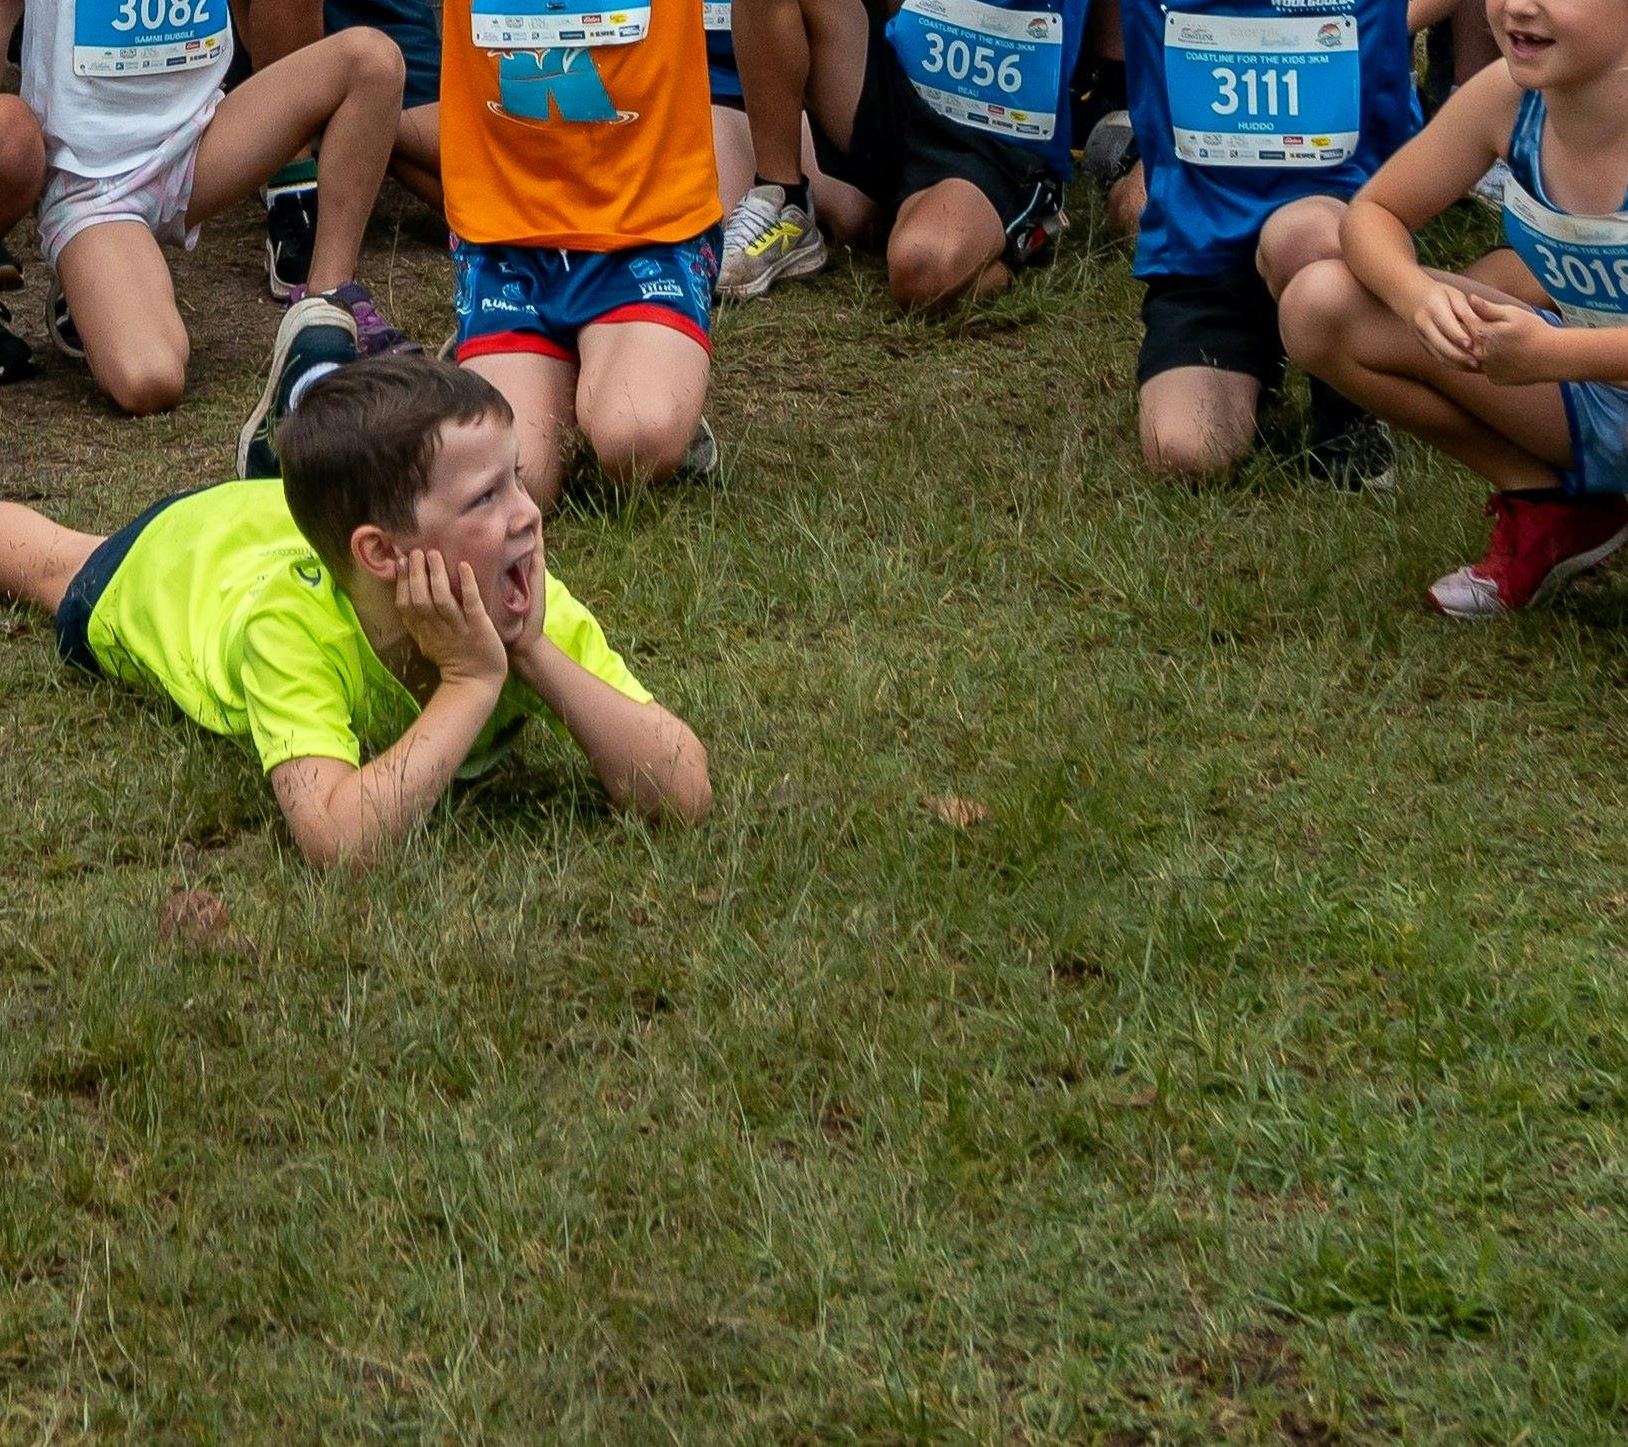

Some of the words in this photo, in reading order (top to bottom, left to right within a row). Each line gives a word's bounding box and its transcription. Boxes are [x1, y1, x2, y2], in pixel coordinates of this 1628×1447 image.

[918, 17, 959, 36] COASTLINE
[960, 31, 977, 42] FOR
[978, 35, 993, 45] THE
[921, 32, 1022, 93] 3056
[1186, 52, 1234, 63] COASTLINE
[1237, 55, 1257, 64] FOR
[1260, 56, 1279, 64] THE
[1282, 55, 1306, 64] KIDS
[1308, 55, 1329, 64] 3KM
[1211, 68, 1298, 115] 3111
